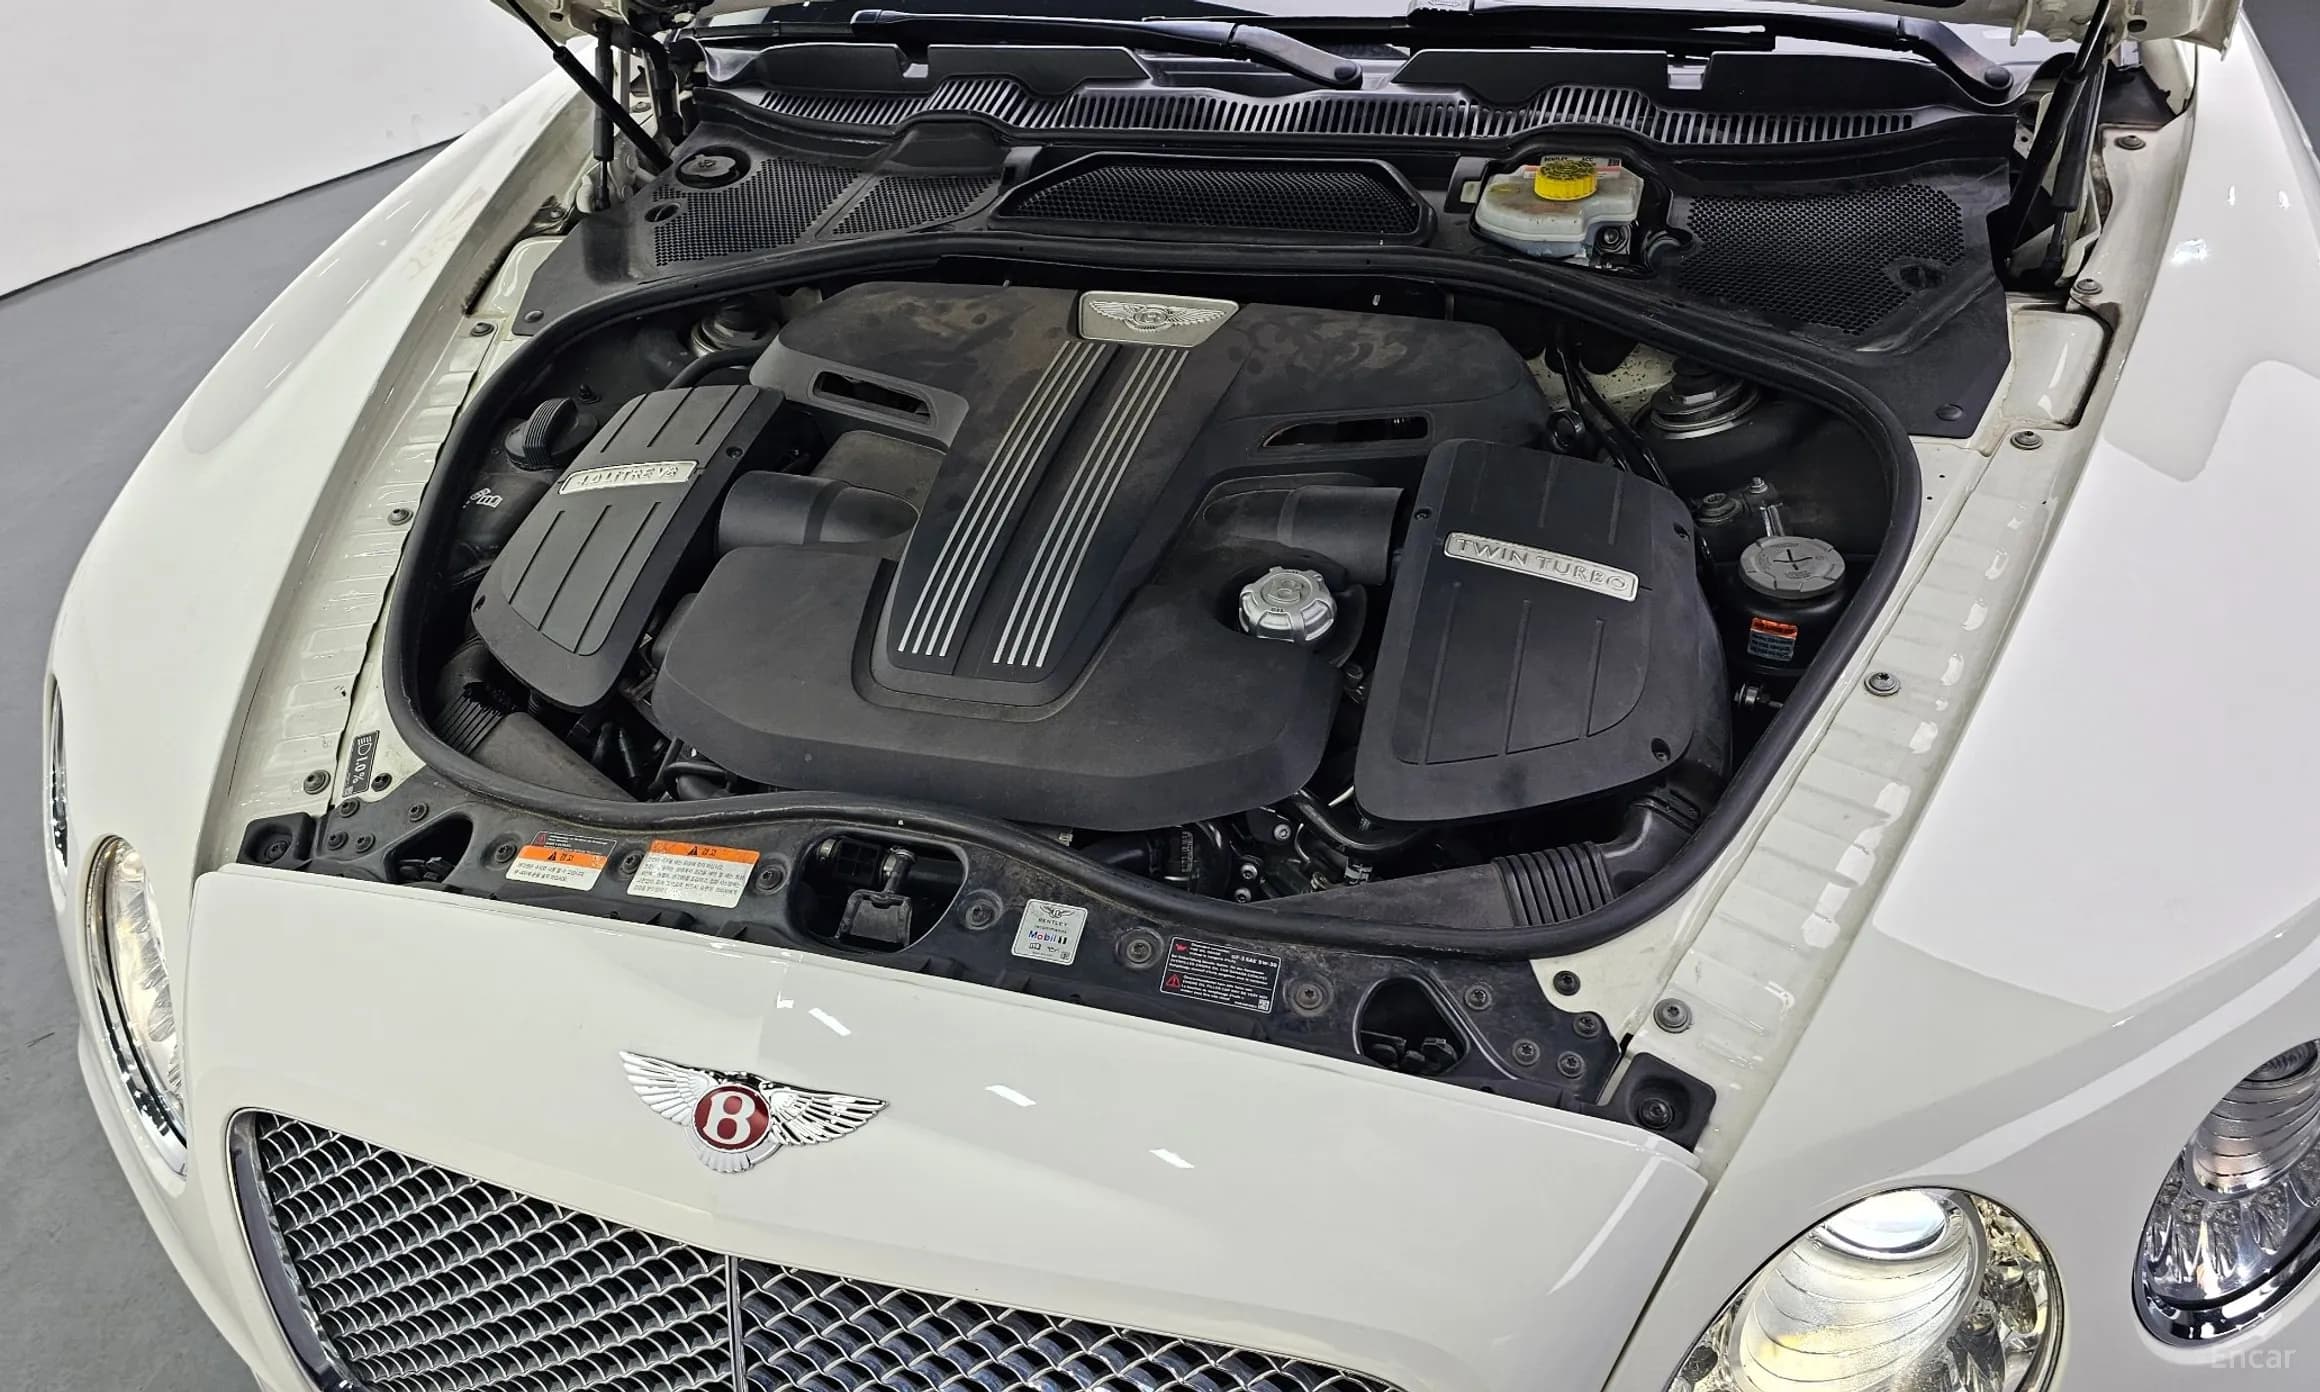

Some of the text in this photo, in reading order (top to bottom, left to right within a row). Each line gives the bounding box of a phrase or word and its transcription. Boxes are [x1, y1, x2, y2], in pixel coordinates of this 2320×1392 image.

[1456, 538, 1628, 592] TWIN TURBO
[352, 755, 369, 784] 1.0%
[1028, 929, 1057, 943] Mobil
[1038, 917, 1068, 927] BENTLEY
[702, 1090, 756, 1146] B
